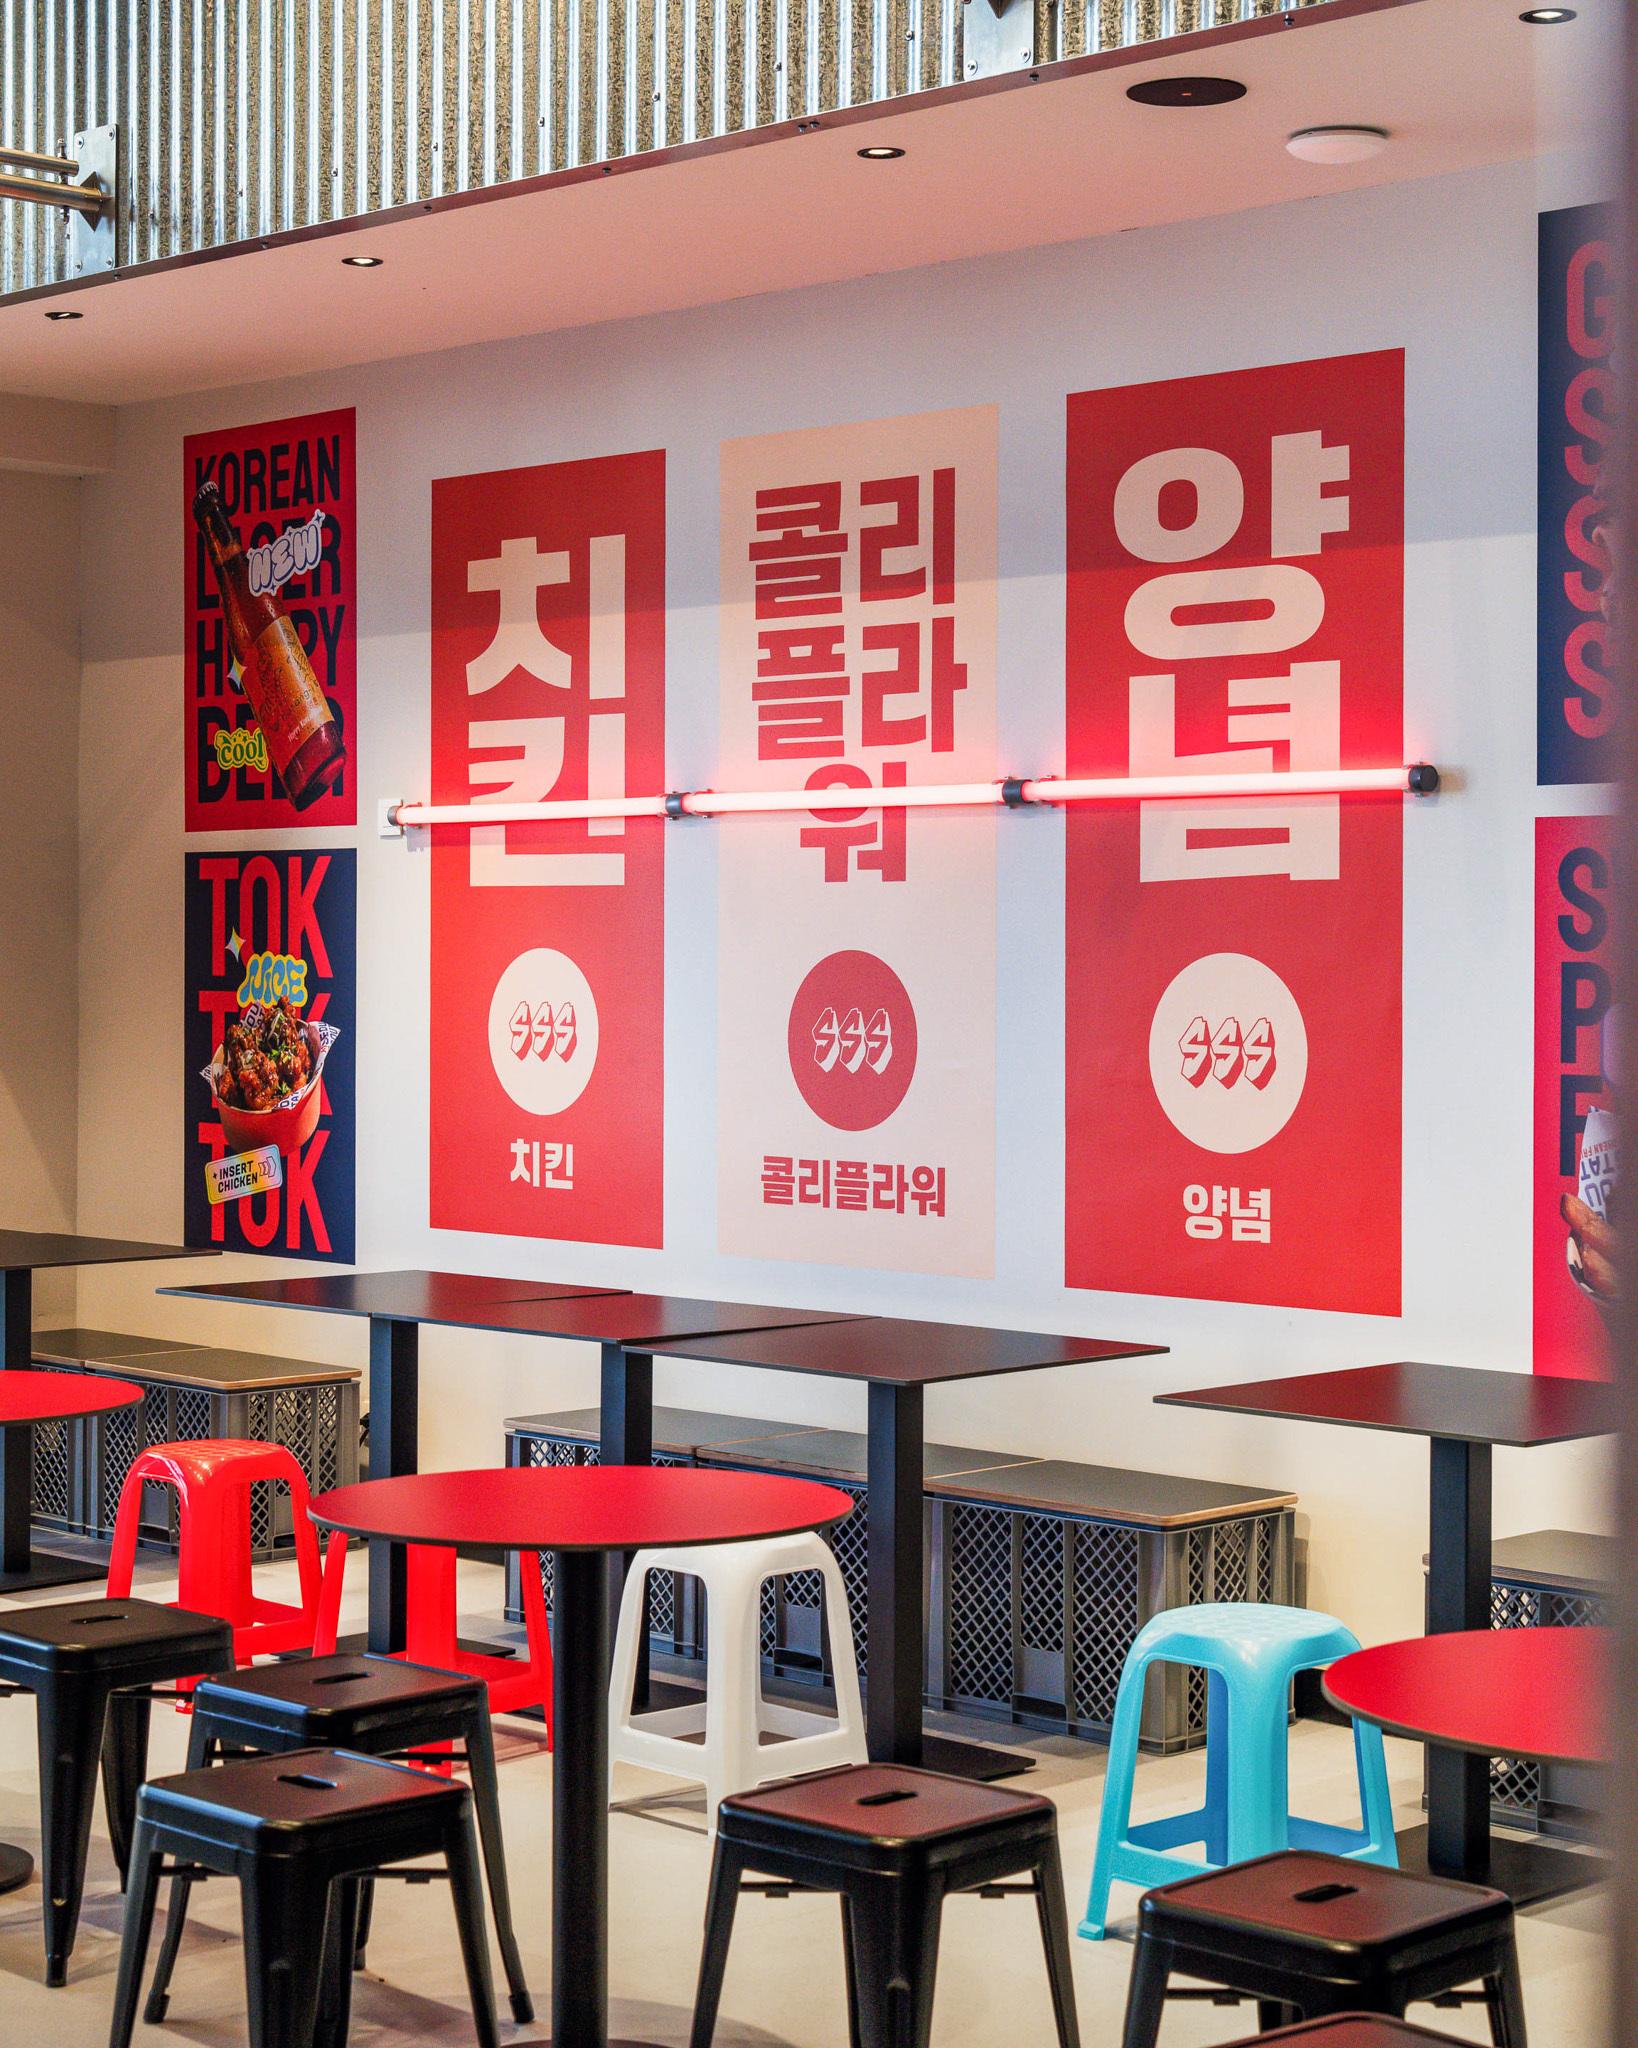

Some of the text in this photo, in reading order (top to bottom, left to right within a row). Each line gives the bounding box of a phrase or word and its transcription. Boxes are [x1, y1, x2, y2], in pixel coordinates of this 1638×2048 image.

[195, 434, 341, 518] KOREAN
[251, 524, 319, 593] NEW
[199, 855, 333, 978] TOK
[239, 957, 306, 1005] NICE
[508, 1001, 577, 1063] SSS
[811, 1006, 893, 1074] SSS
[1178, 1016, 1277, 1090] SSS
[218, 1172, 258, 1193] CHICKEN
[220, 1160, 254, 1180] INSERT
[509, 1138, 575, 1190] 치킨
[761, 1155, 947, 1218] 콜리플라워
[1182, 1185, 1272, 1244] 양념
